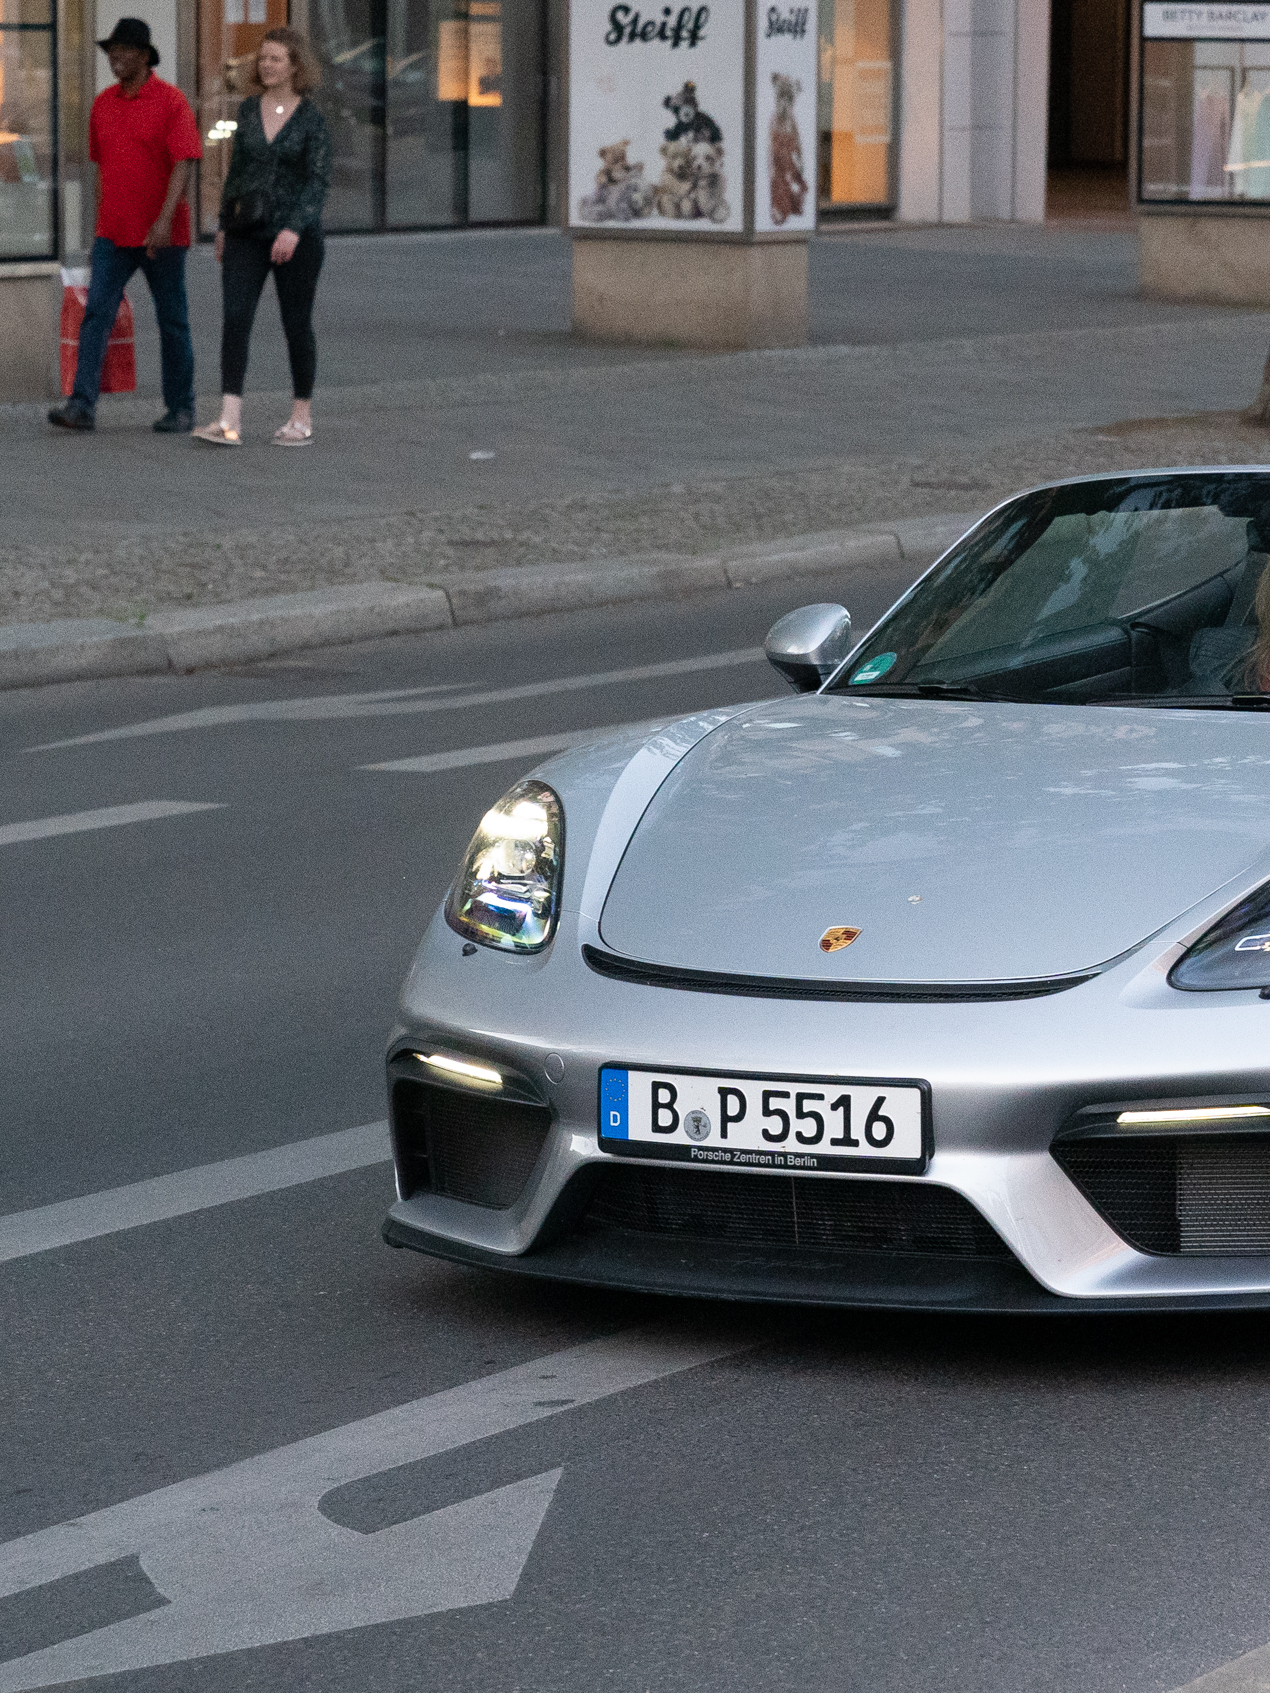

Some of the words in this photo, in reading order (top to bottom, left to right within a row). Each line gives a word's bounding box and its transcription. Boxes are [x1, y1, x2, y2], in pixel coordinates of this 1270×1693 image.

[604, 3, 711, 49] Steiff
[765, 6, 810, 40] Steiff
[1162, 8, 1203, 23] BETTY
[1207, 10, 1268, 24] BARCLAY
[609, 1110, 620, 1127] D
[651, 1080, 680, 1134] B
[717, 1086, 747, 1139] P
[762, 1089, 895, 1149] 5516
[691, 1147, 732, 1162] Porsche
[733, 1151, 772, 1164] Zentren
[774, 1153, 784, 1165] in
[787, 1154, 817, 1167] Berlin
